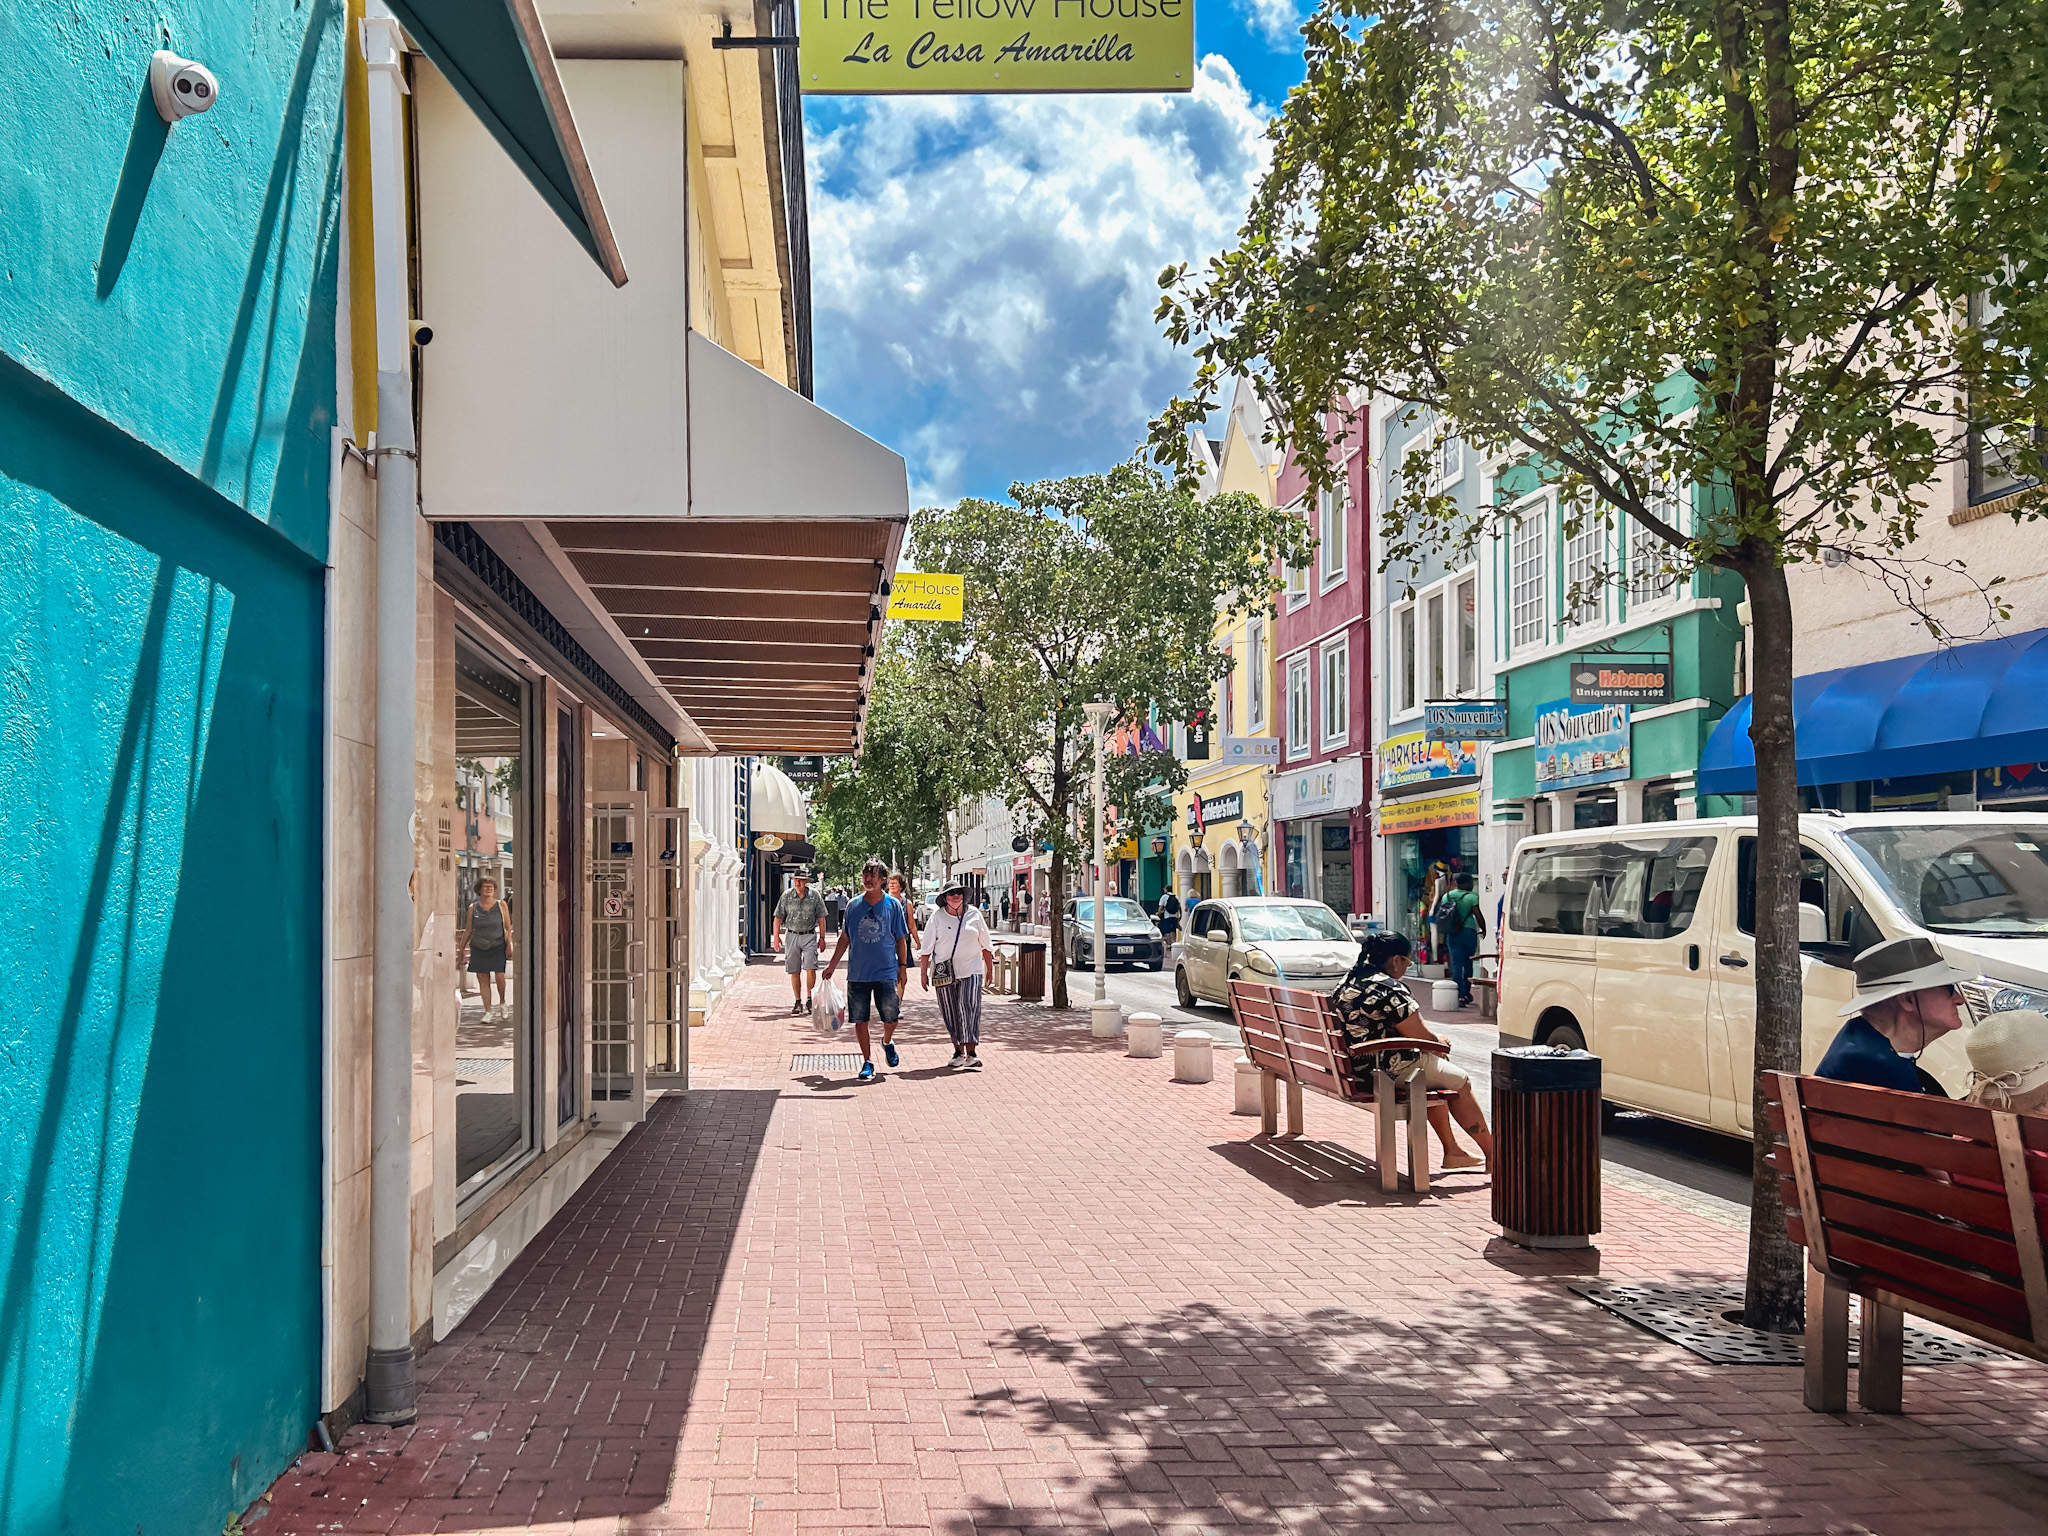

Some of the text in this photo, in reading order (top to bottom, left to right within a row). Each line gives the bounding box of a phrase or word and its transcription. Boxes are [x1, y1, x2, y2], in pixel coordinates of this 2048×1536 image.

[843, 31, 1136, 69] La Casa Amarilla
[913, 580, 960, 596] House
[892, 597, 942, 611] Amarilla
[1599, 669, 1665, 688] Habanos
[1576, 688, 1664, 697] Unique since 1492
[1448, 708, 1503, 724] Souvenir's
[1559, 704, 1623, 742] Souvenir's
